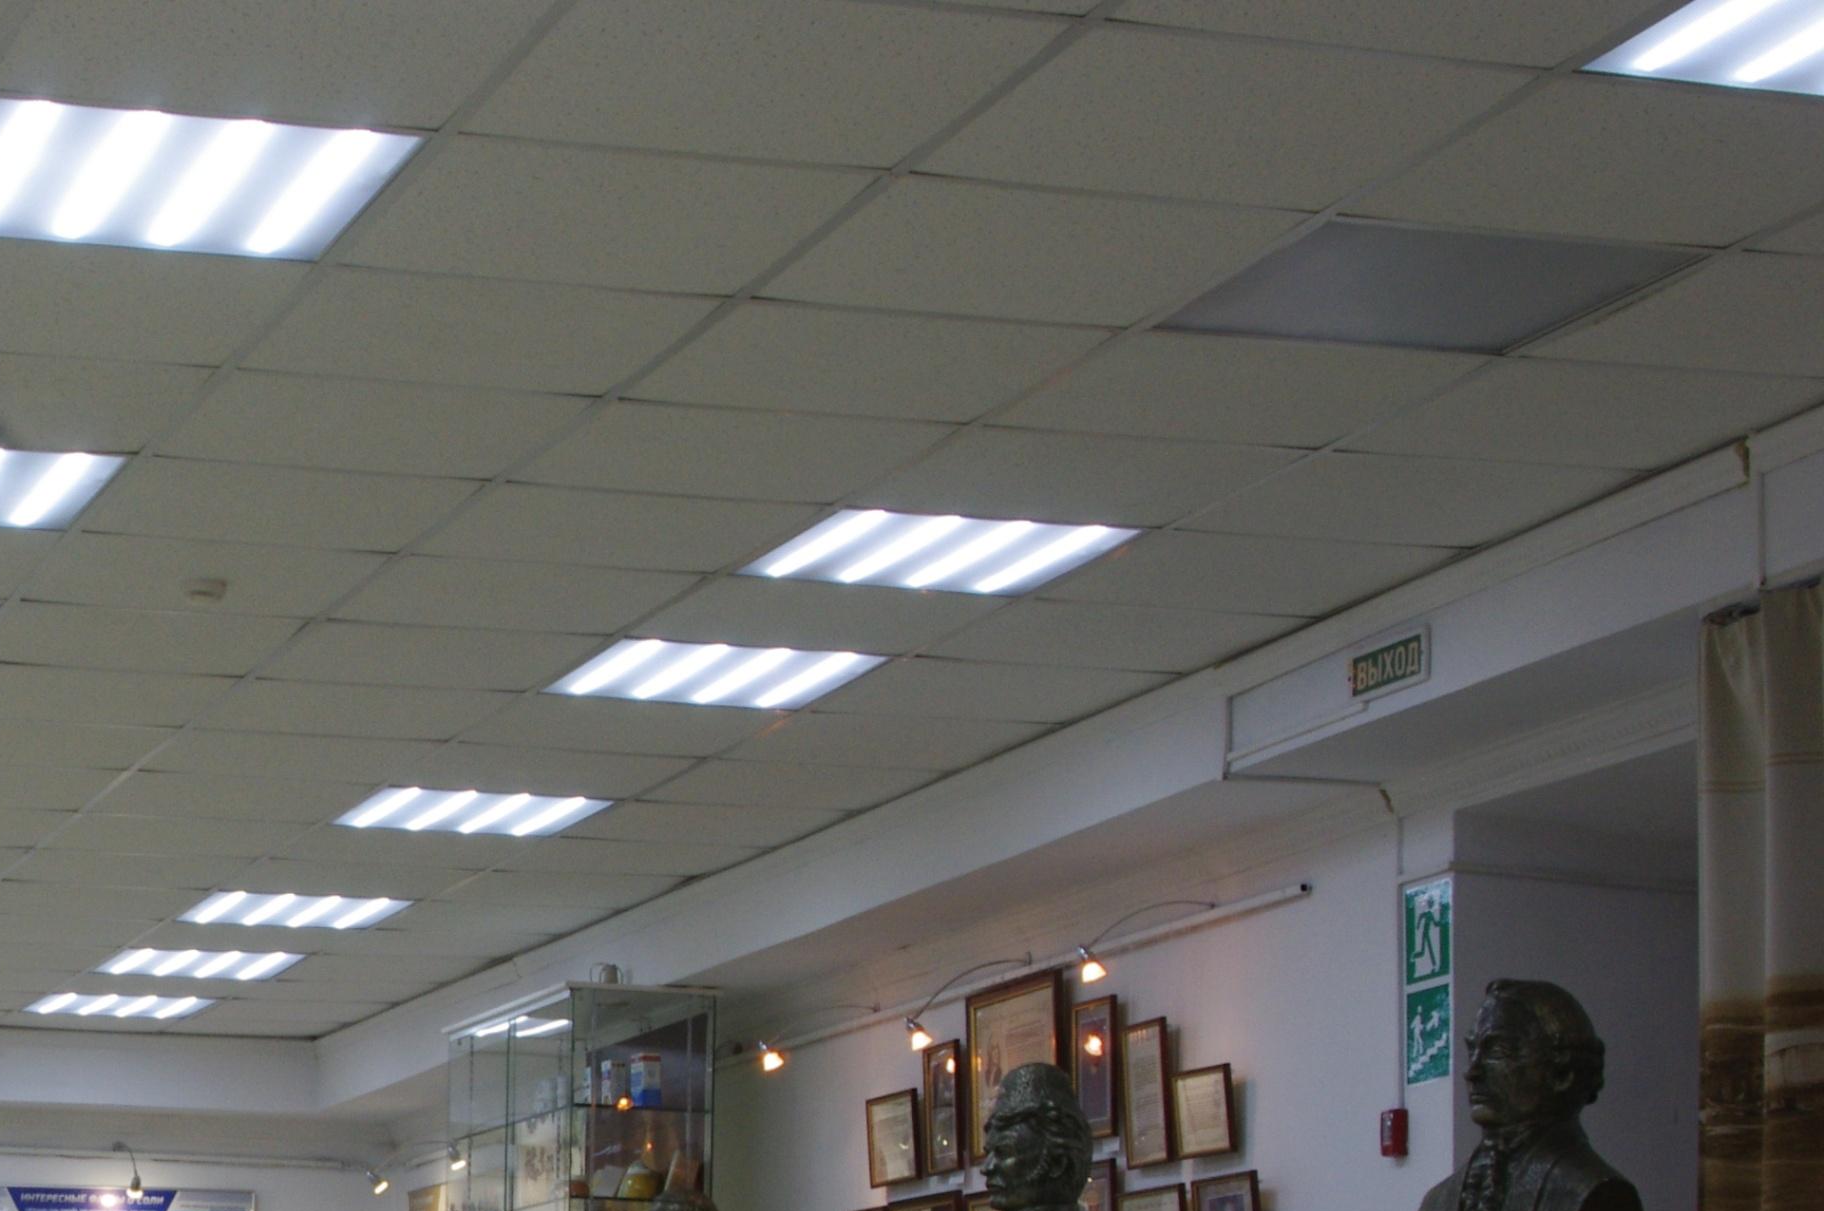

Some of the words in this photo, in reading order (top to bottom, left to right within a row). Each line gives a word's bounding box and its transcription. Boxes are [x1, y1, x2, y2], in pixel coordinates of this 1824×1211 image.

[1356, 641, 1420, 691] ВЫХОД
[20, 1193, 87, 1203] ИНТЕРЕСНЫЕ
[136, 1196, 165, 1205] СОЛИ
